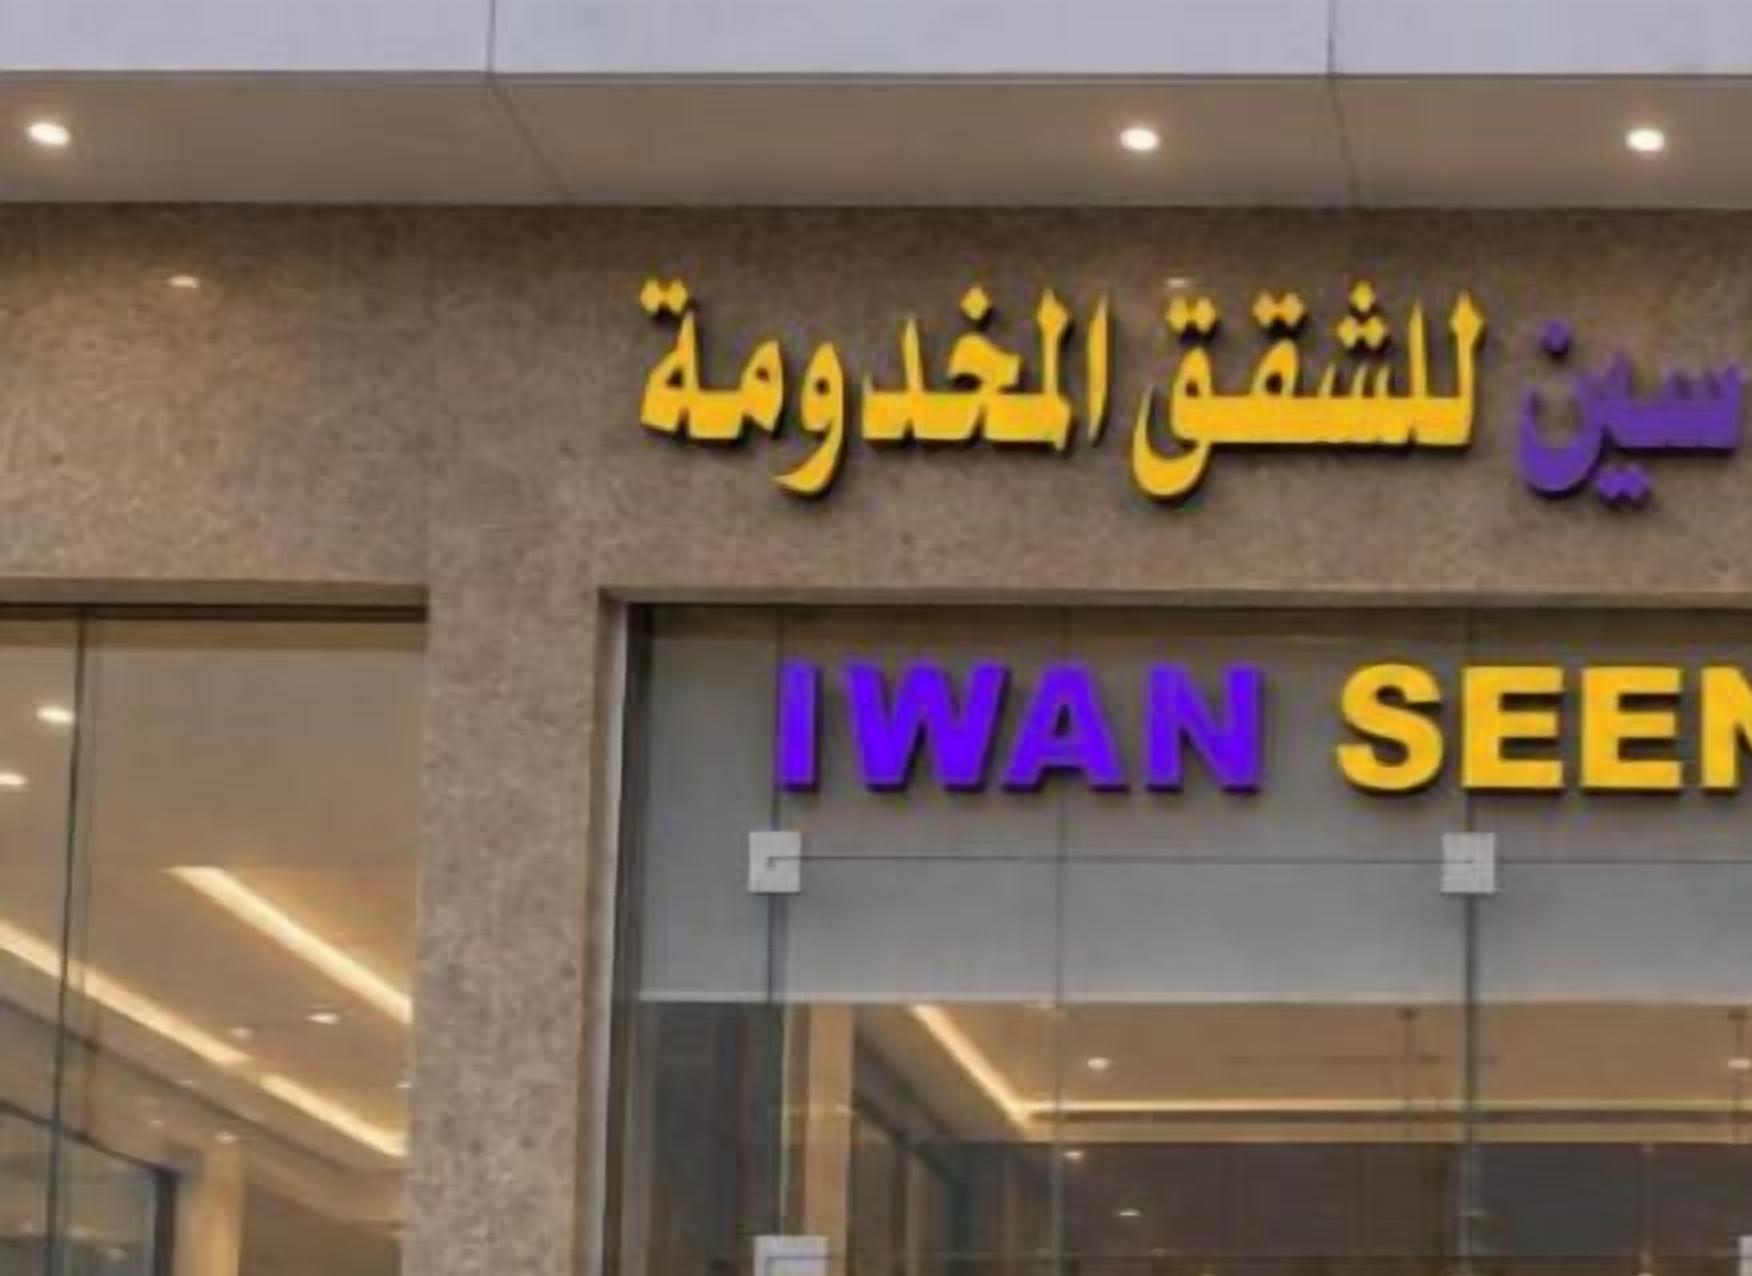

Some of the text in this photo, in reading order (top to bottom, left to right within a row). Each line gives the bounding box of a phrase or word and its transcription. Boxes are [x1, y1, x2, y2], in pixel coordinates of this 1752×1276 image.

[639, 280, 1112, 493] المخدومة
[1131, 284, 1486, 498] للشقق
[1515, 320, 1745, 503] سين
[774, 661, 1266, 793] IWAN
